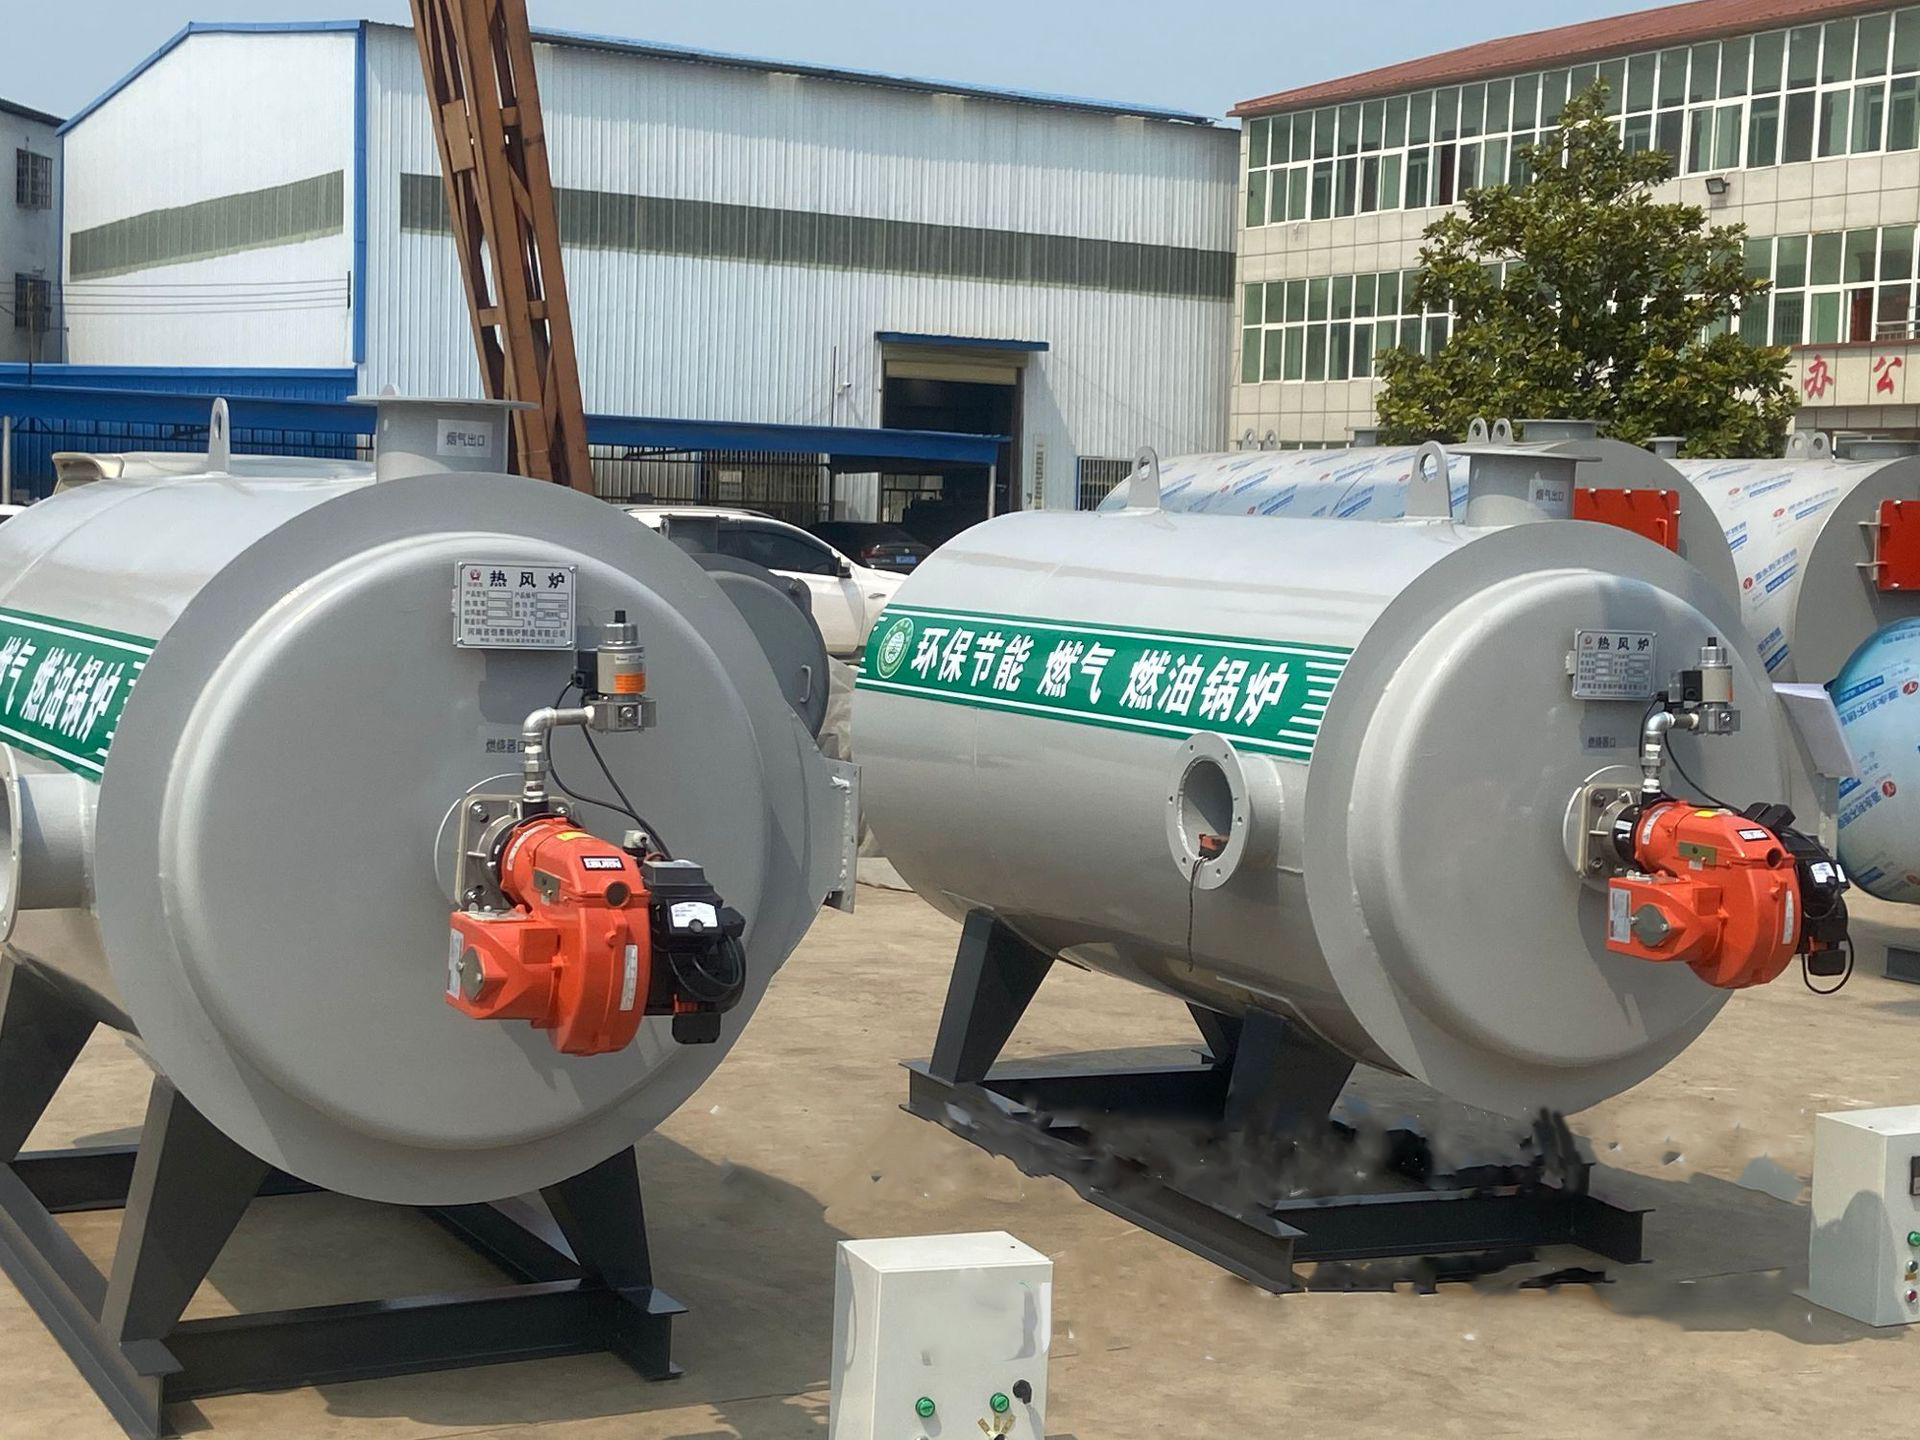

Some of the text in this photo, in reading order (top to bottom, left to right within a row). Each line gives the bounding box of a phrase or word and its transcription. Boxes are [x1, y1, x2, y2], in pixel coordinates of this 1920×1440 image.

[1804, 354, 1902, 399] 办公
[490, 570, 565, 589] 热风炉
[1598, 635, 1650, 651] 热风炉
[20, 646, 125, 744] 燃油锅炉
[911, 626, 1034, 690] 环保节能
[1036, 640, 1116, 705] 燃气
[1120, 649, 1290, 726] 燃油锅炉
